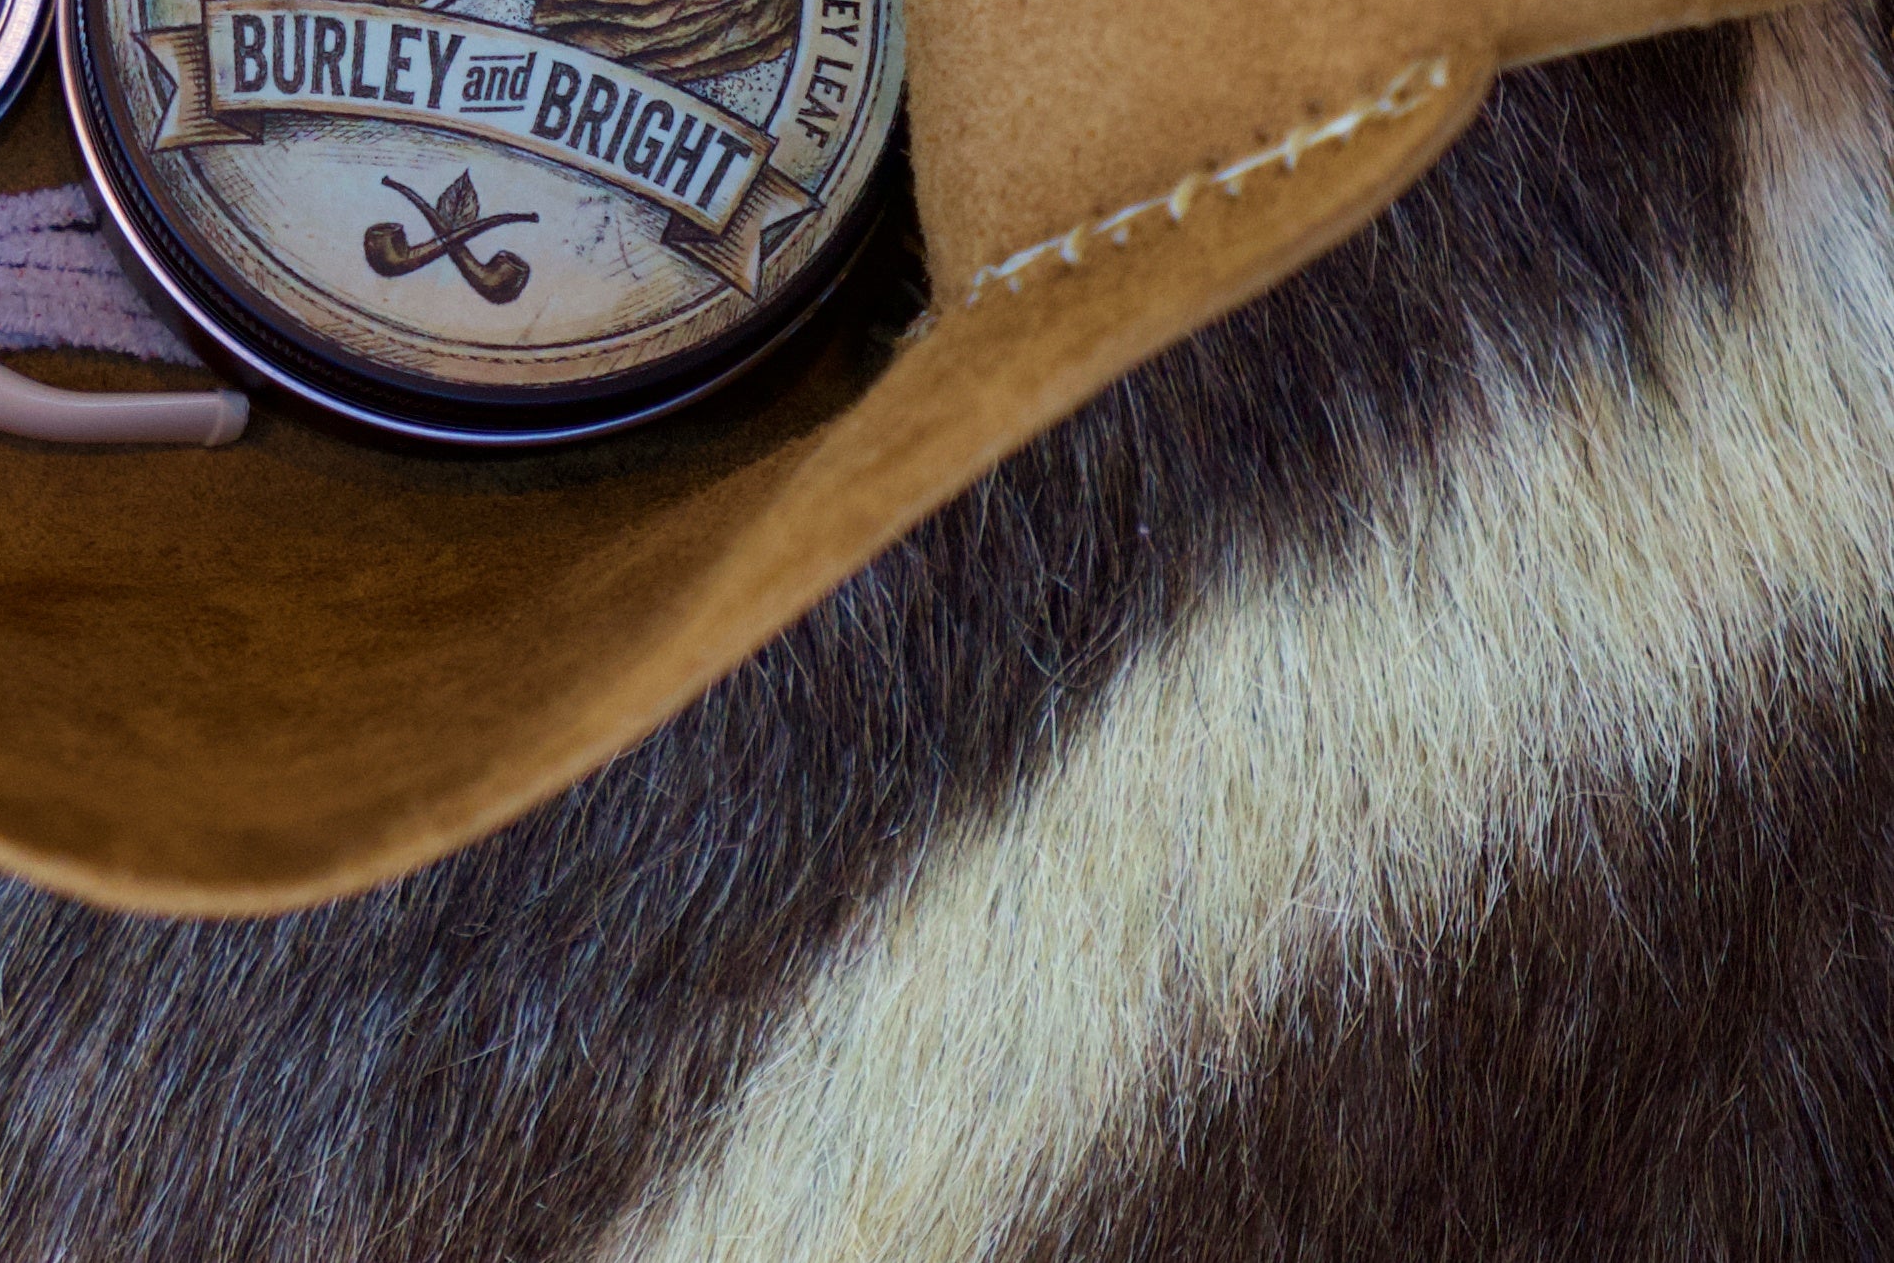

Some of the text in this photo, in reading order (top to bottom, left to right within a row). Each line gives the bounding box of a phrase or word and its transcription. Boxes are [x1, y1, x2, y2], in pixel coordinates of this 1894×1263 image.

[231, 13, 753, 209] BURLEY and BRIGHT
[795, 55, 853, 149] LEAF
